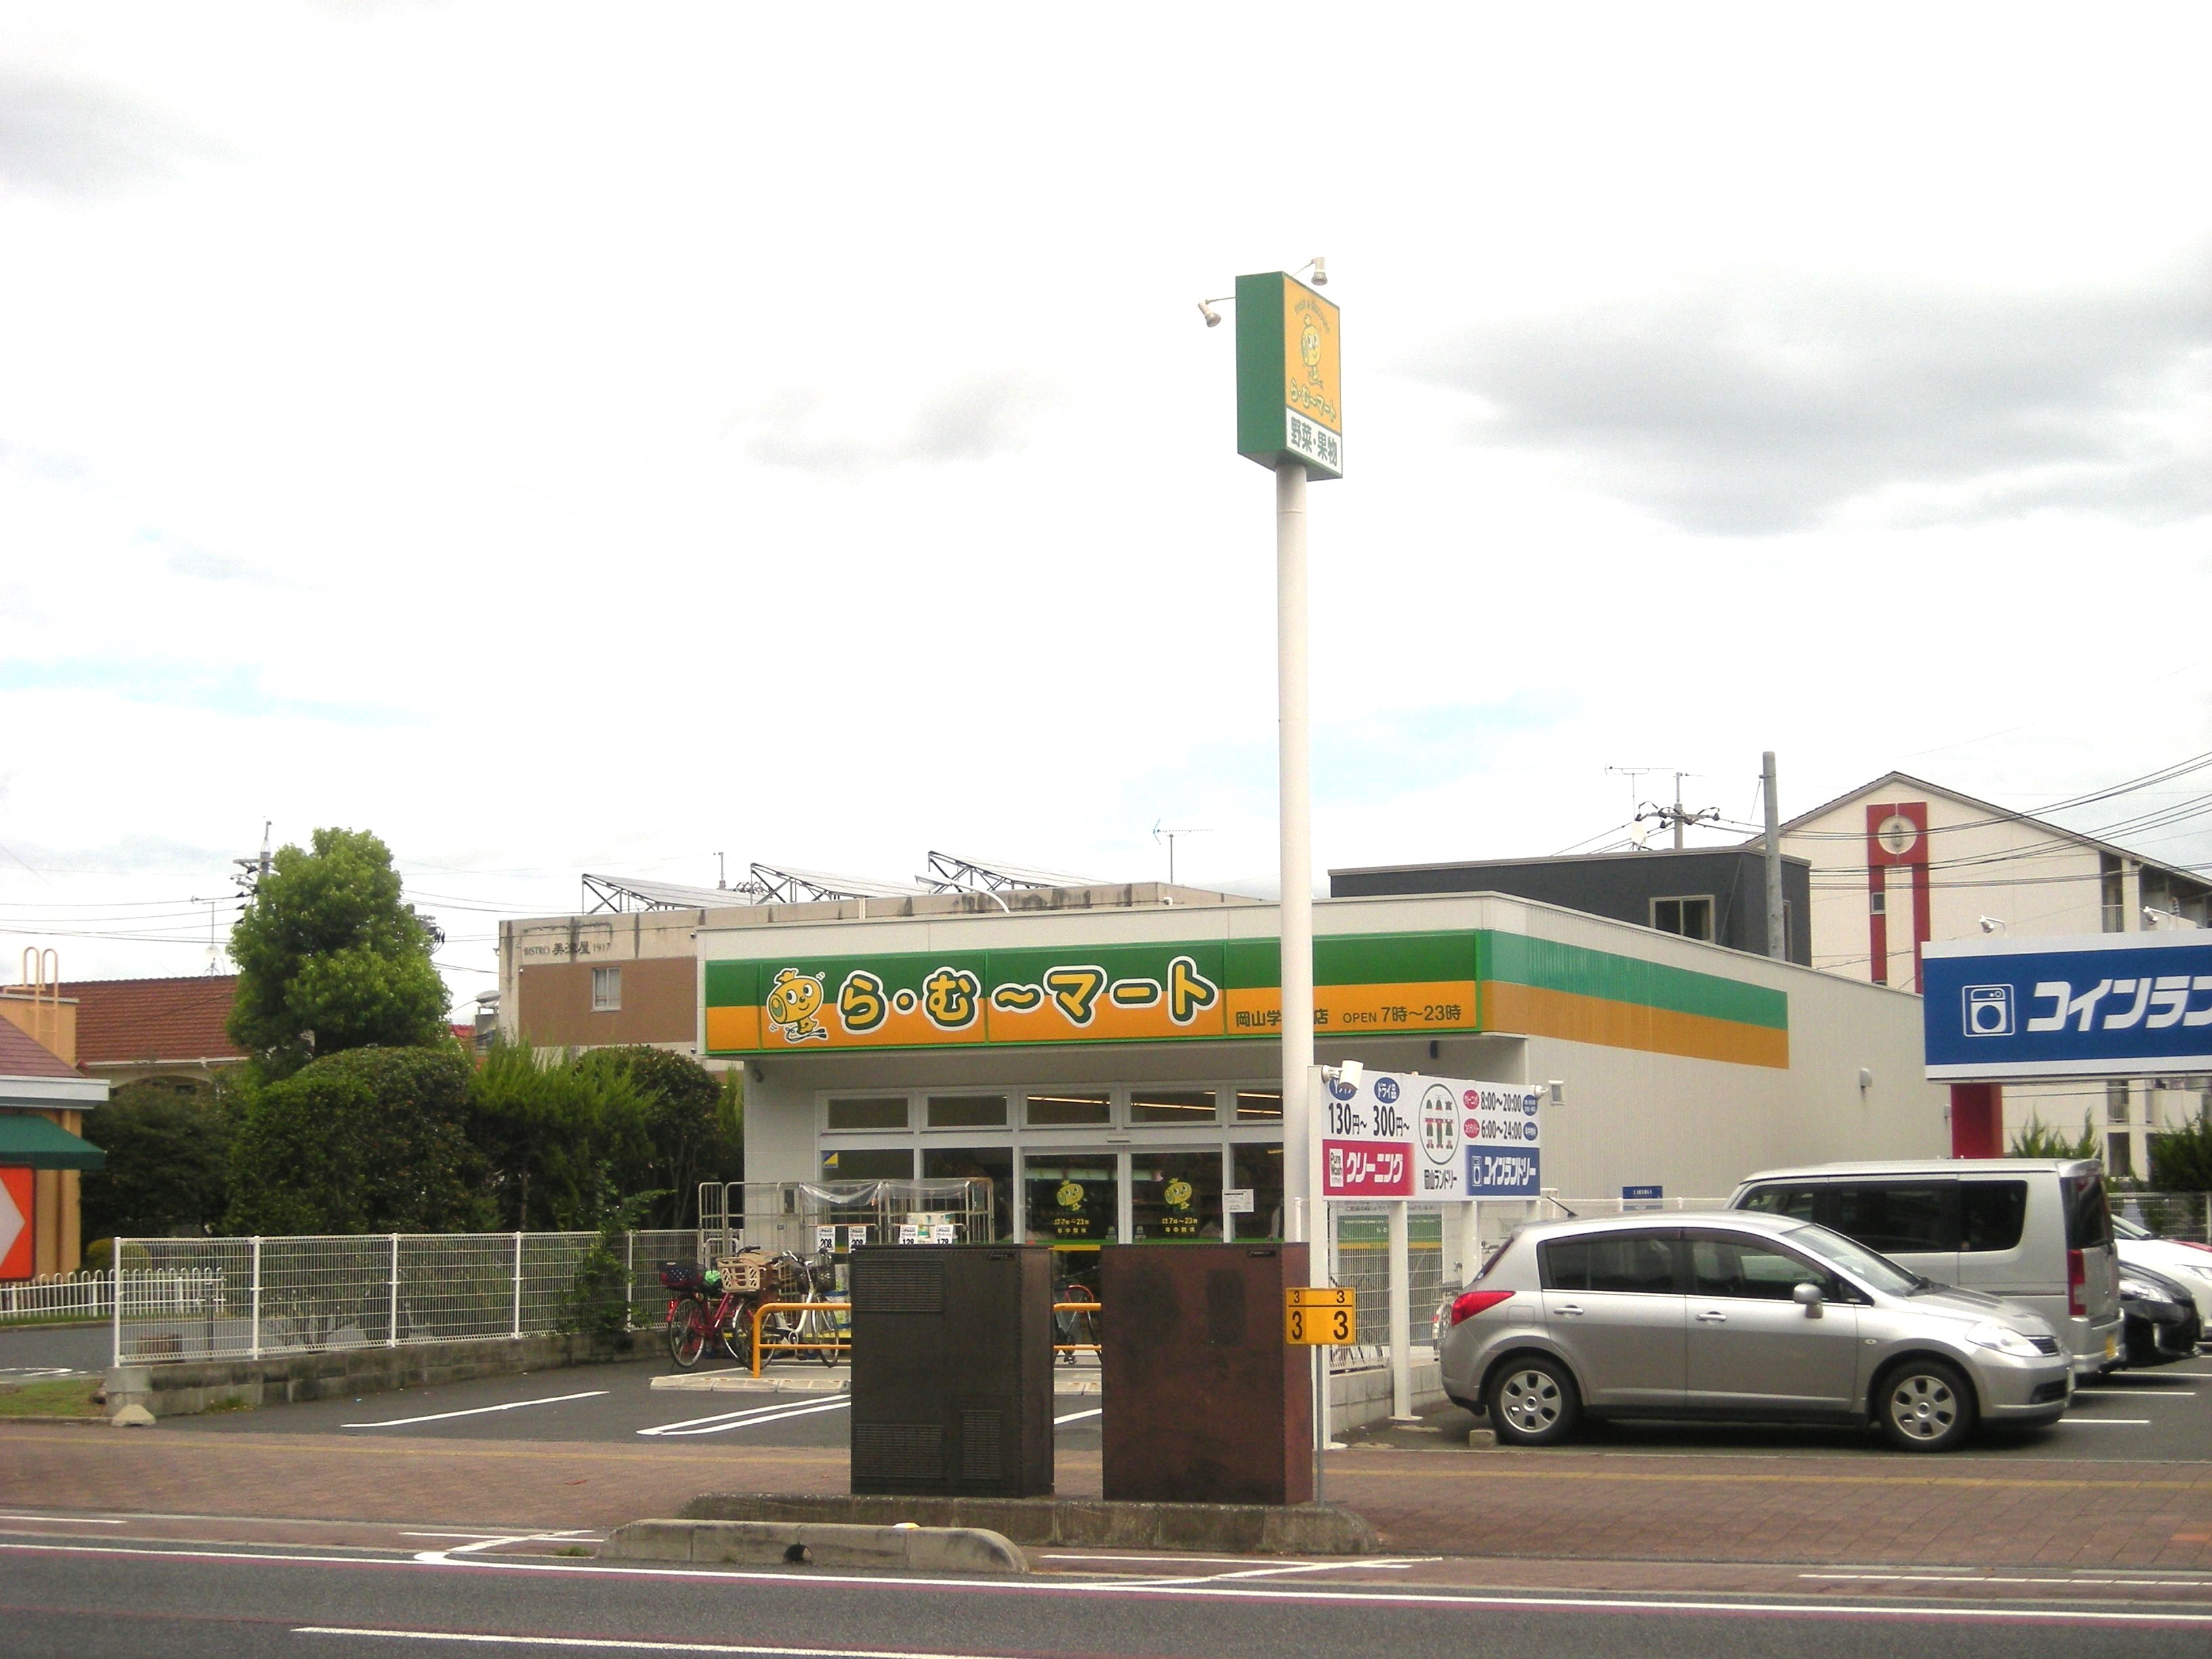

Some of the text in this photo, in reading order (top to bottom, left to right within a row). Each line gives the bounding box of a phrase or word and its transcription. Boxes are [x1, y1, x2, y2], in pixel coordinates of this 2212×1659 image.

[1291, 417, 1337, 467] 野菜・果物
[1343, 1012, 1376, 1023] OPEN
[1378, 1082, 1397, 1099] ドライ品
[1347, 1152, 1404, 1183] クリーニング
[1483, 1156, 1536, 1186] コインランドリー
[1294, 1290, 1300, 1303] 3
[1336, 1290, 1345, 1303] 3
[1292, 1311, 1303, 1340] 3
[1333, 1311, 1349, 1340] 3
